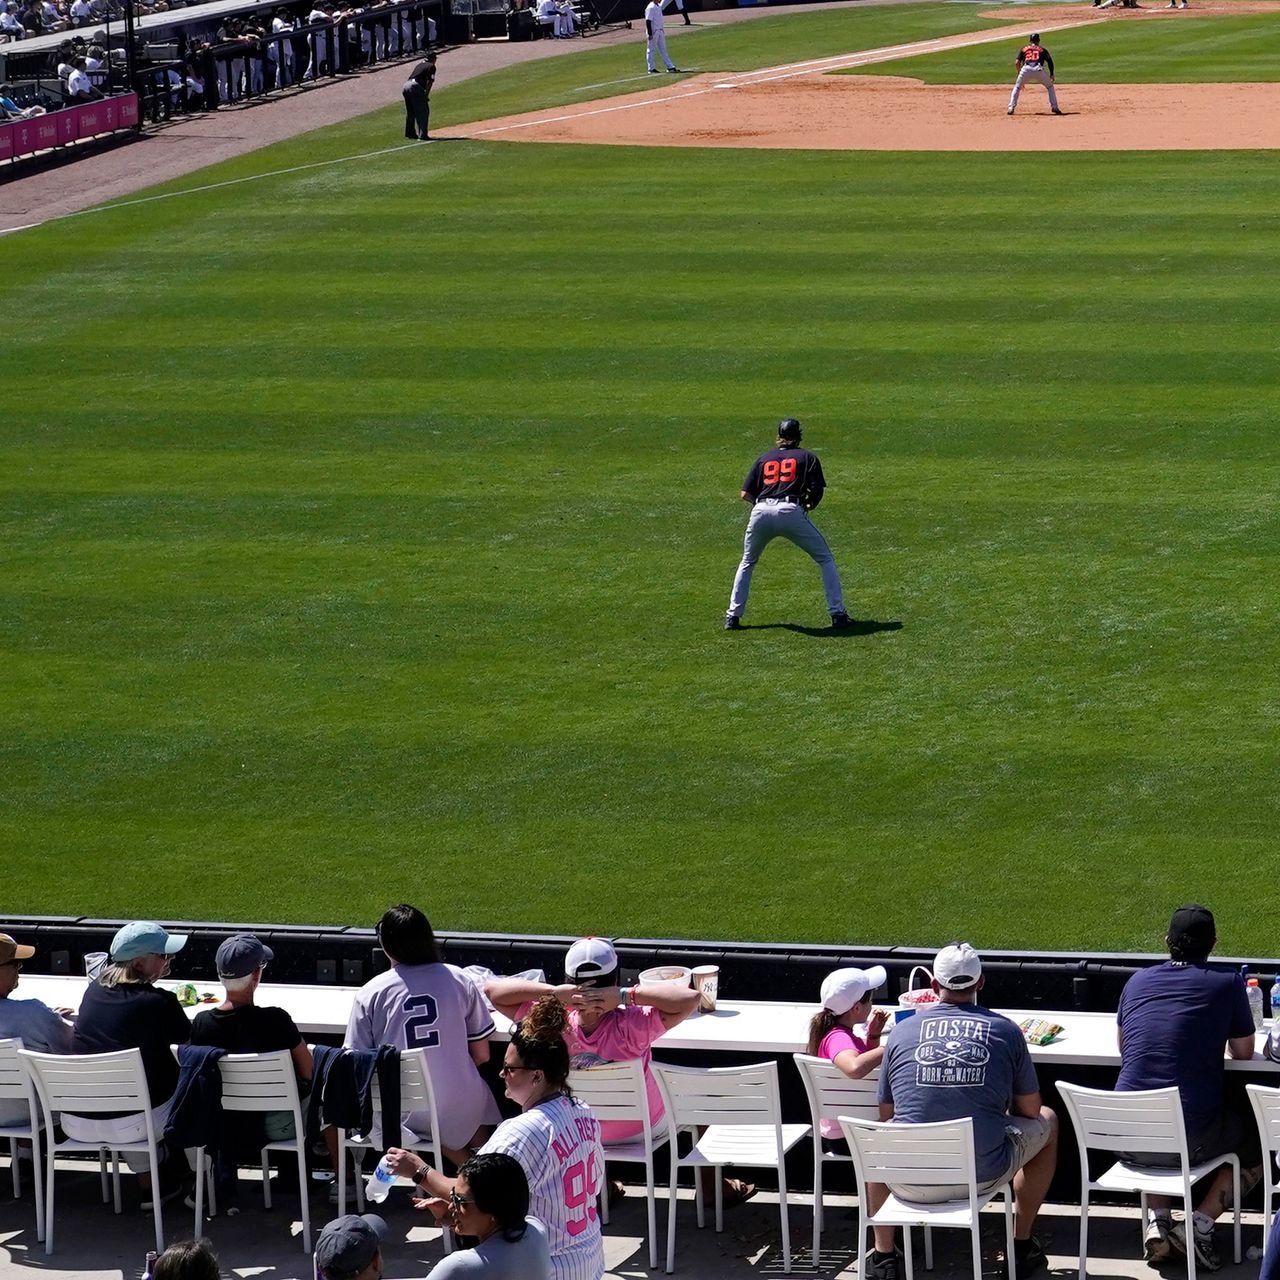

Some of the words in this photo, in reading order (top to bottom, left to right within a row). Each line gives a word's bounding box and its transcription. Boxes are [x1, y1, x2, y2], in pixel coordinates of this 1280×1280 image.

[763, 458, 798, 486] 99
[402, 994, 440, 1050] 2
[926, 1020, 984, 1040] COSTA
[920, 1046, 934, 1058] DEL
[922, 1067, 942, 1082] BORN
[956, 1067, 982, 1082] WATER
[552, 1126, 579, 1164] ALL
